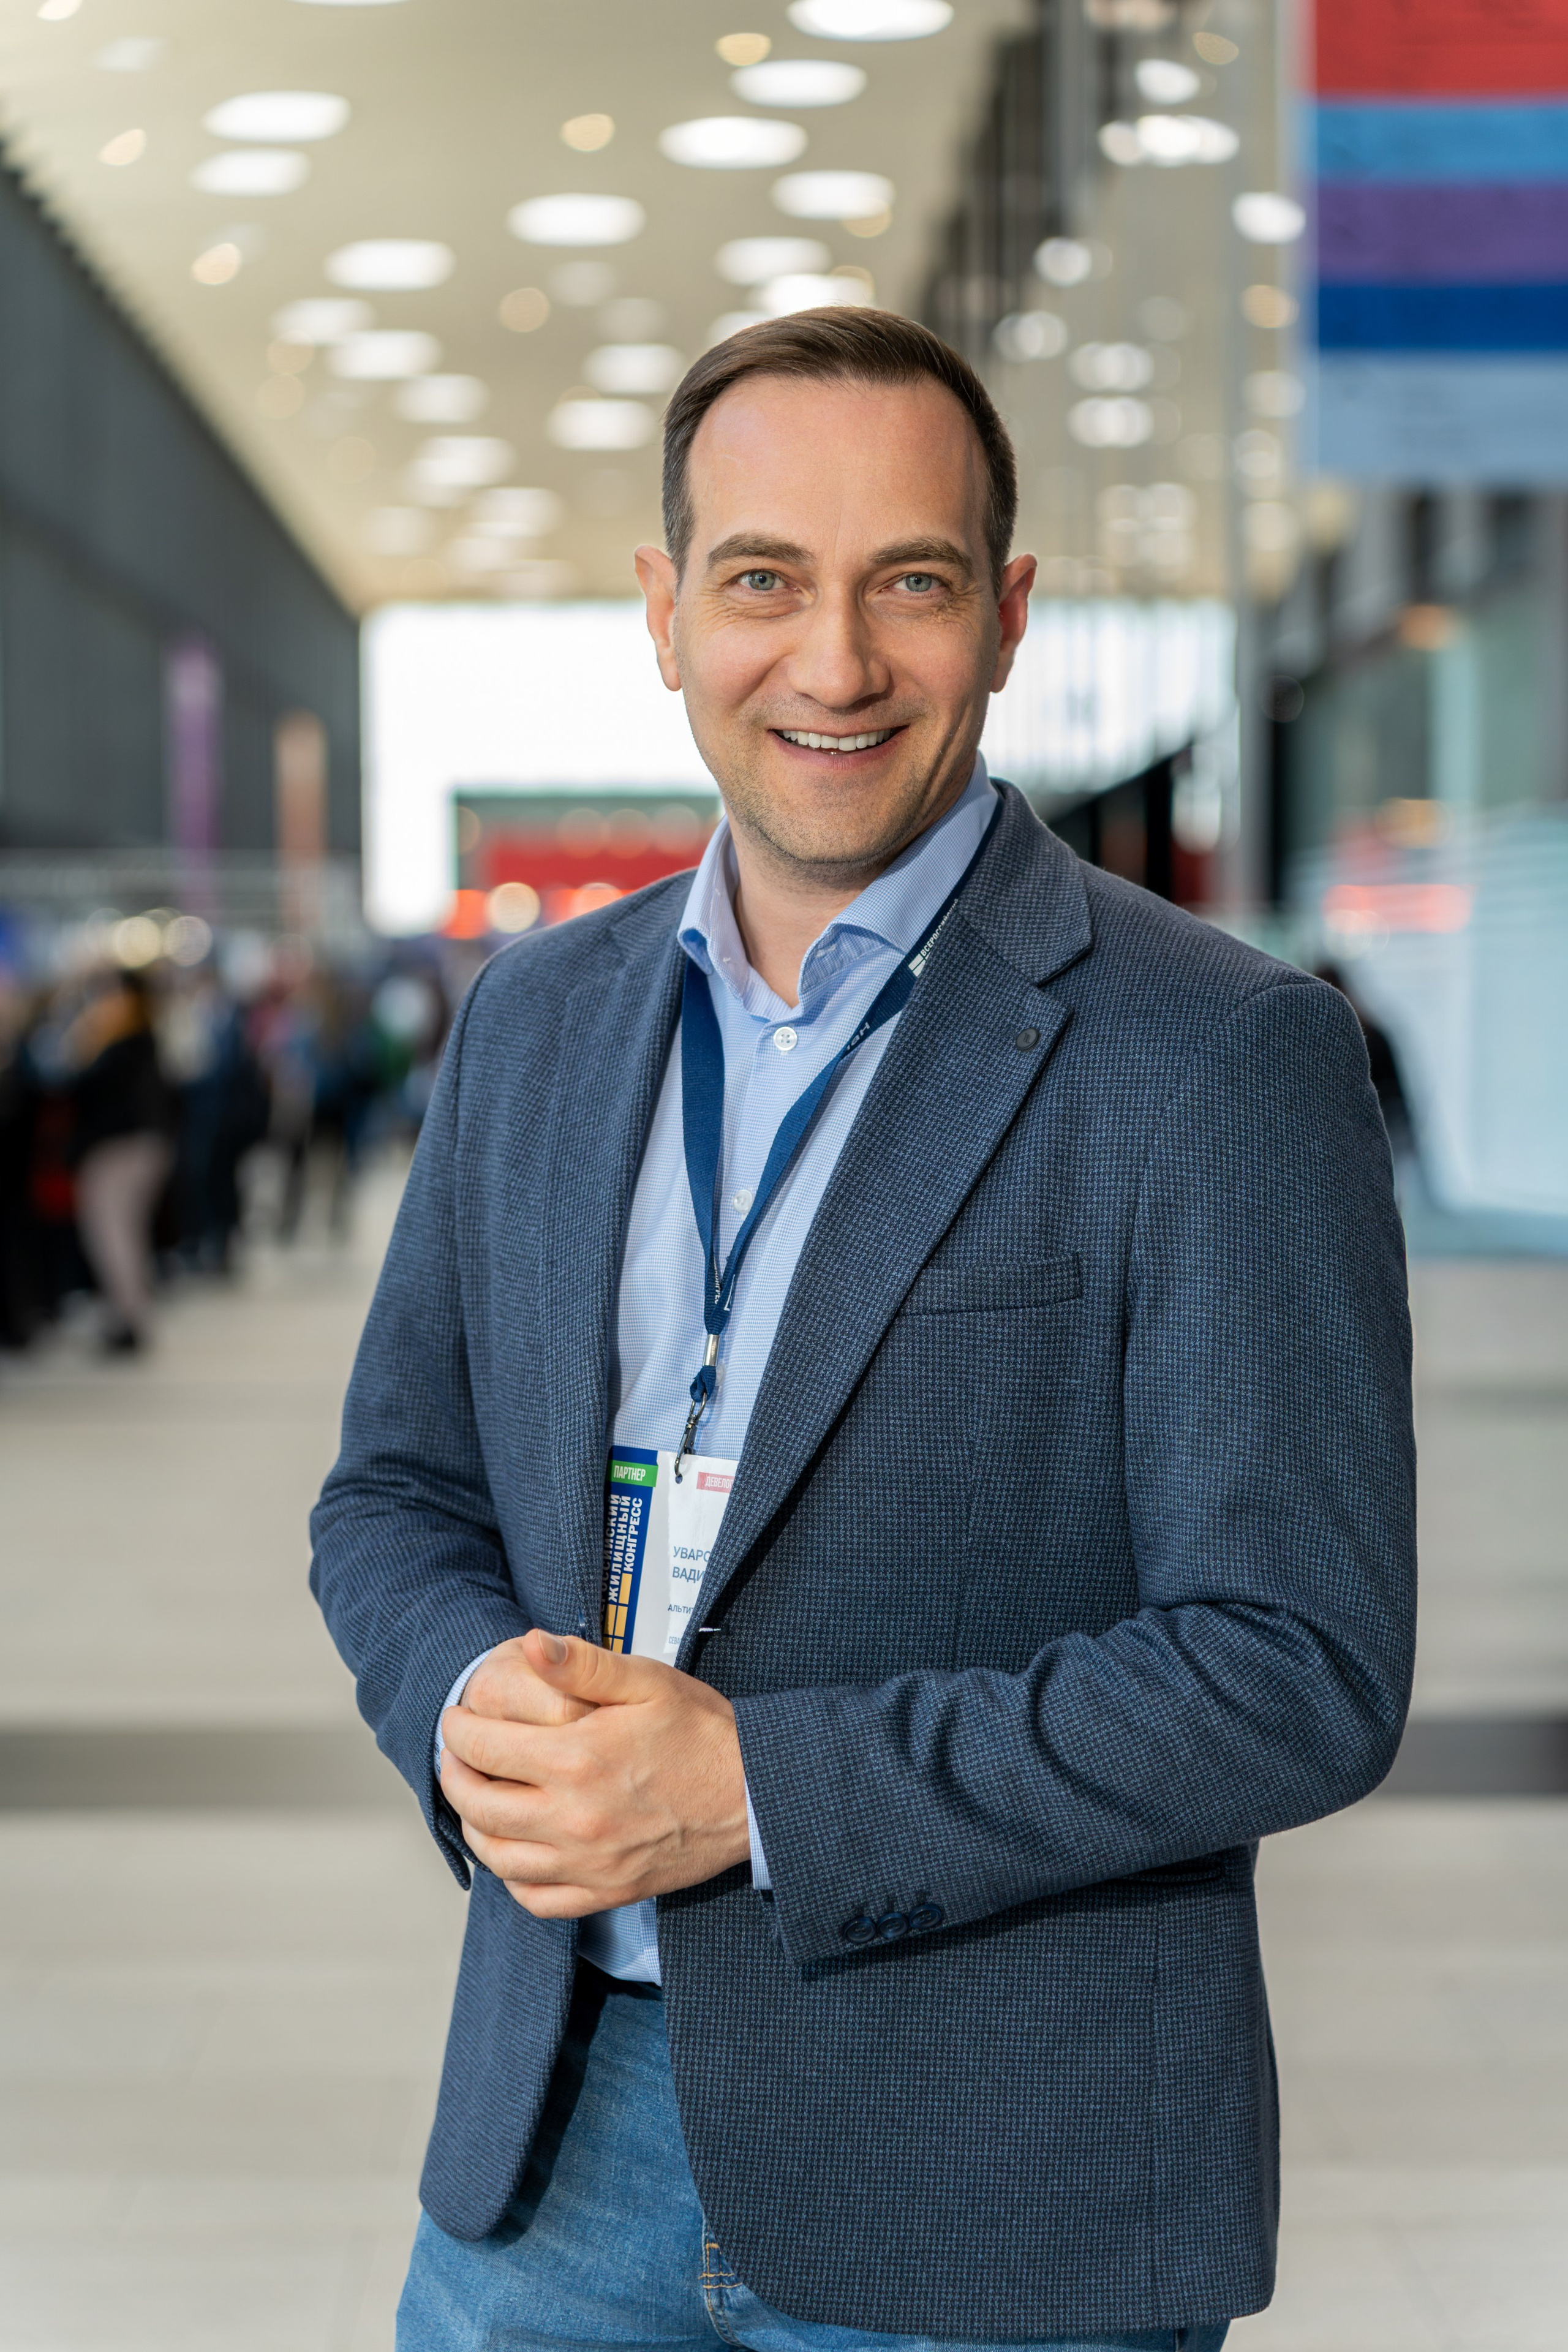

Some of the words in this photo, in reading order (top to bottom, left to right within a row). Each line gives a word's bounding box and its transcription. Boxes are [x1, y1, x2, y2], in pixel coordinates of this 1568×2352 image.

[614, 1465, 646, 1481] ПАРТНЕР
[608, 1496, 631, 1602] ЖИЛИЩНЫЙ
[623, 1498, 643, 1572] КОНГРЕСС
